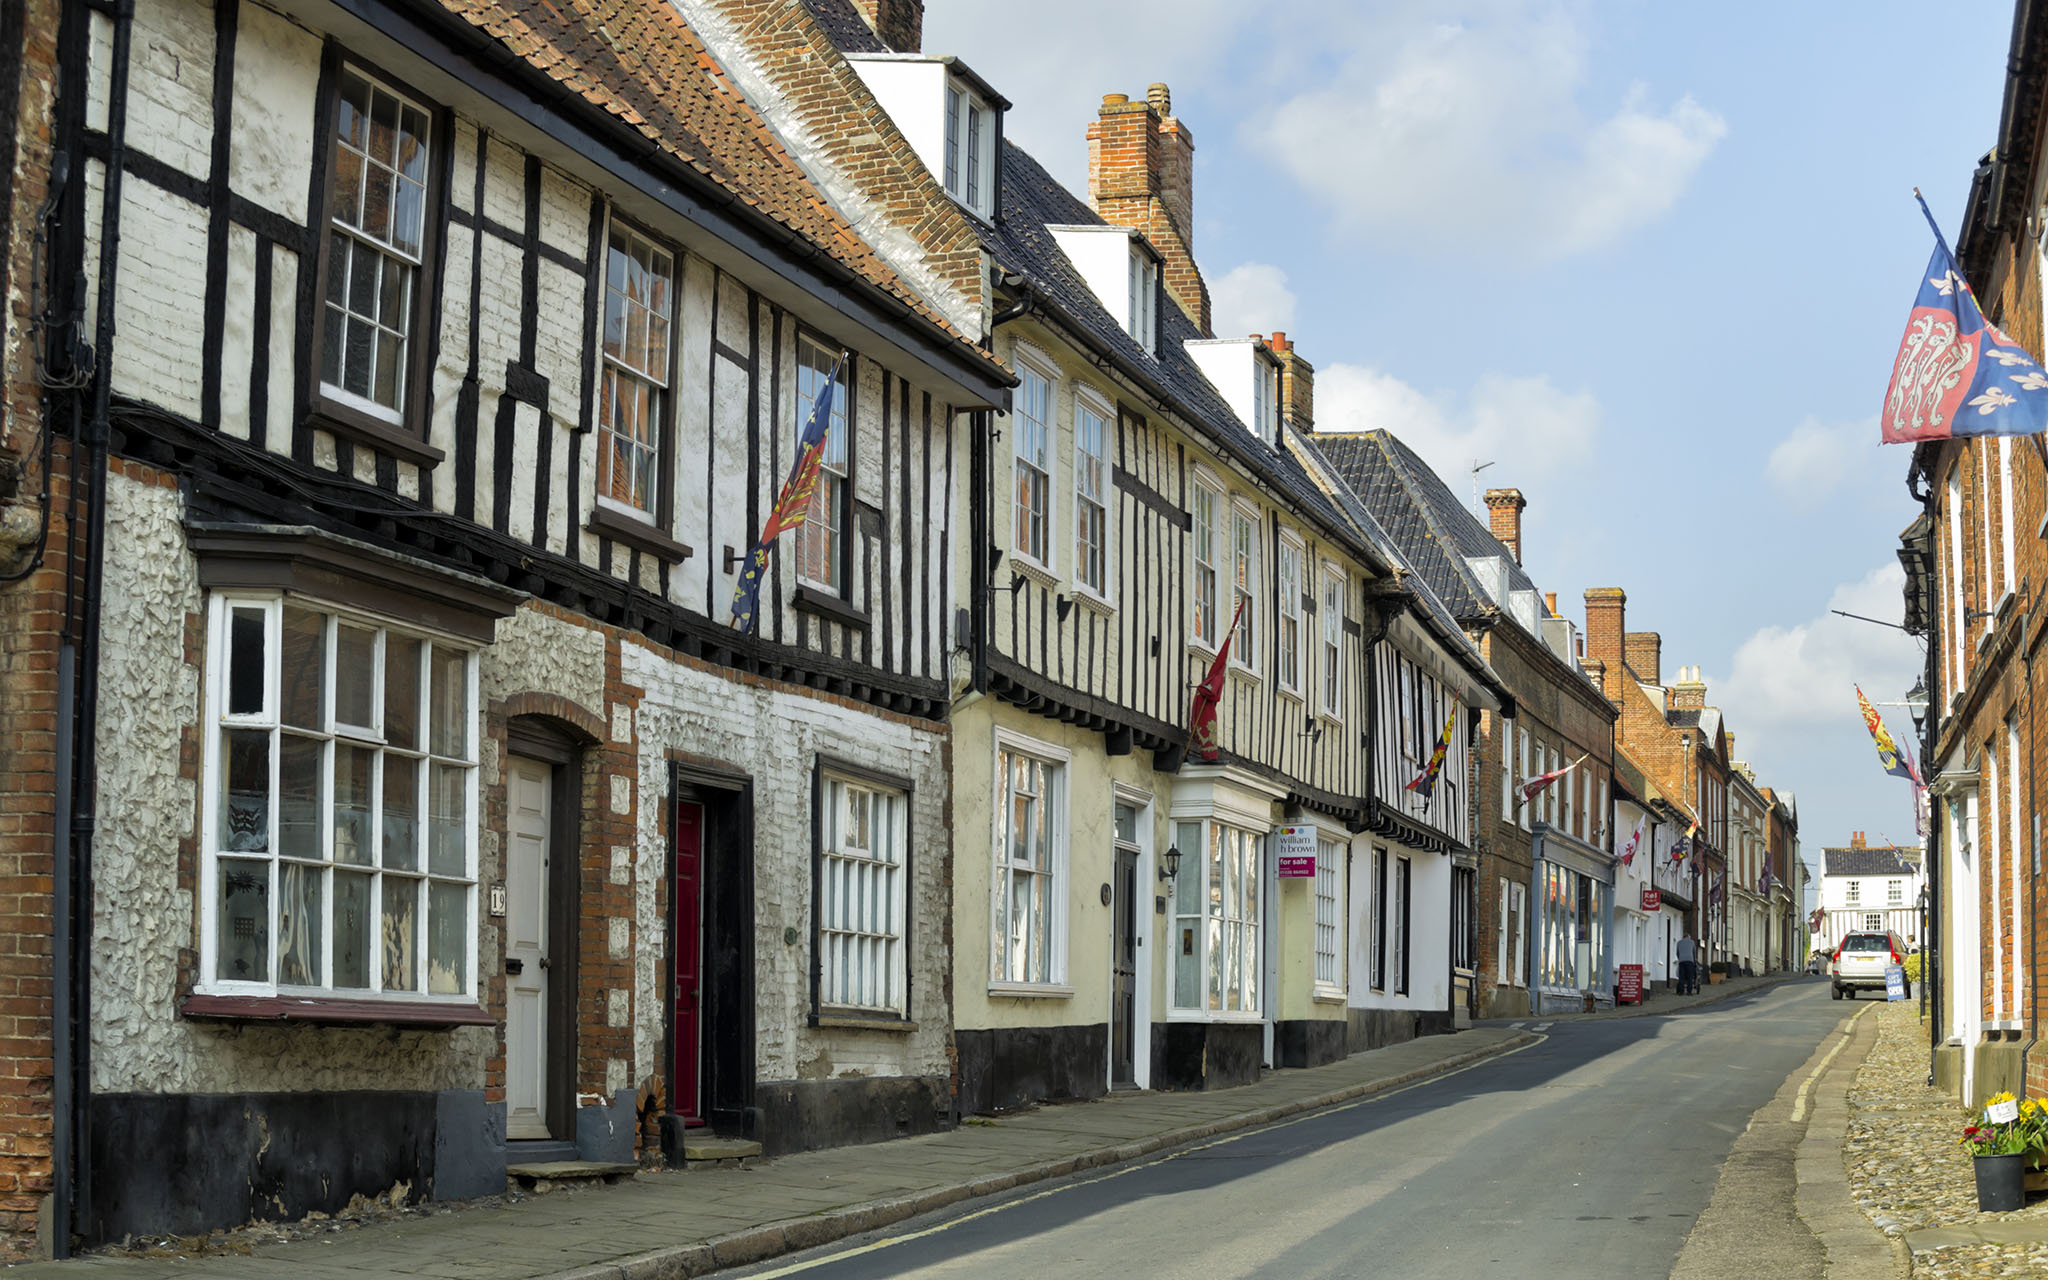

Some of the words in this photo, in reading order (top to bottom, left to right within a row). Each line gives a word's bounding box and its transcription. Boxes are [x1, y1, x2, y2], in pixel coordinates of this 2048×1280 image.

[1280, 836, 1310, 844] william
[1280, 845, 1286, 853] h
[1288, 845, 1315, 853] brown
[493, 893, 505, 910] 19
